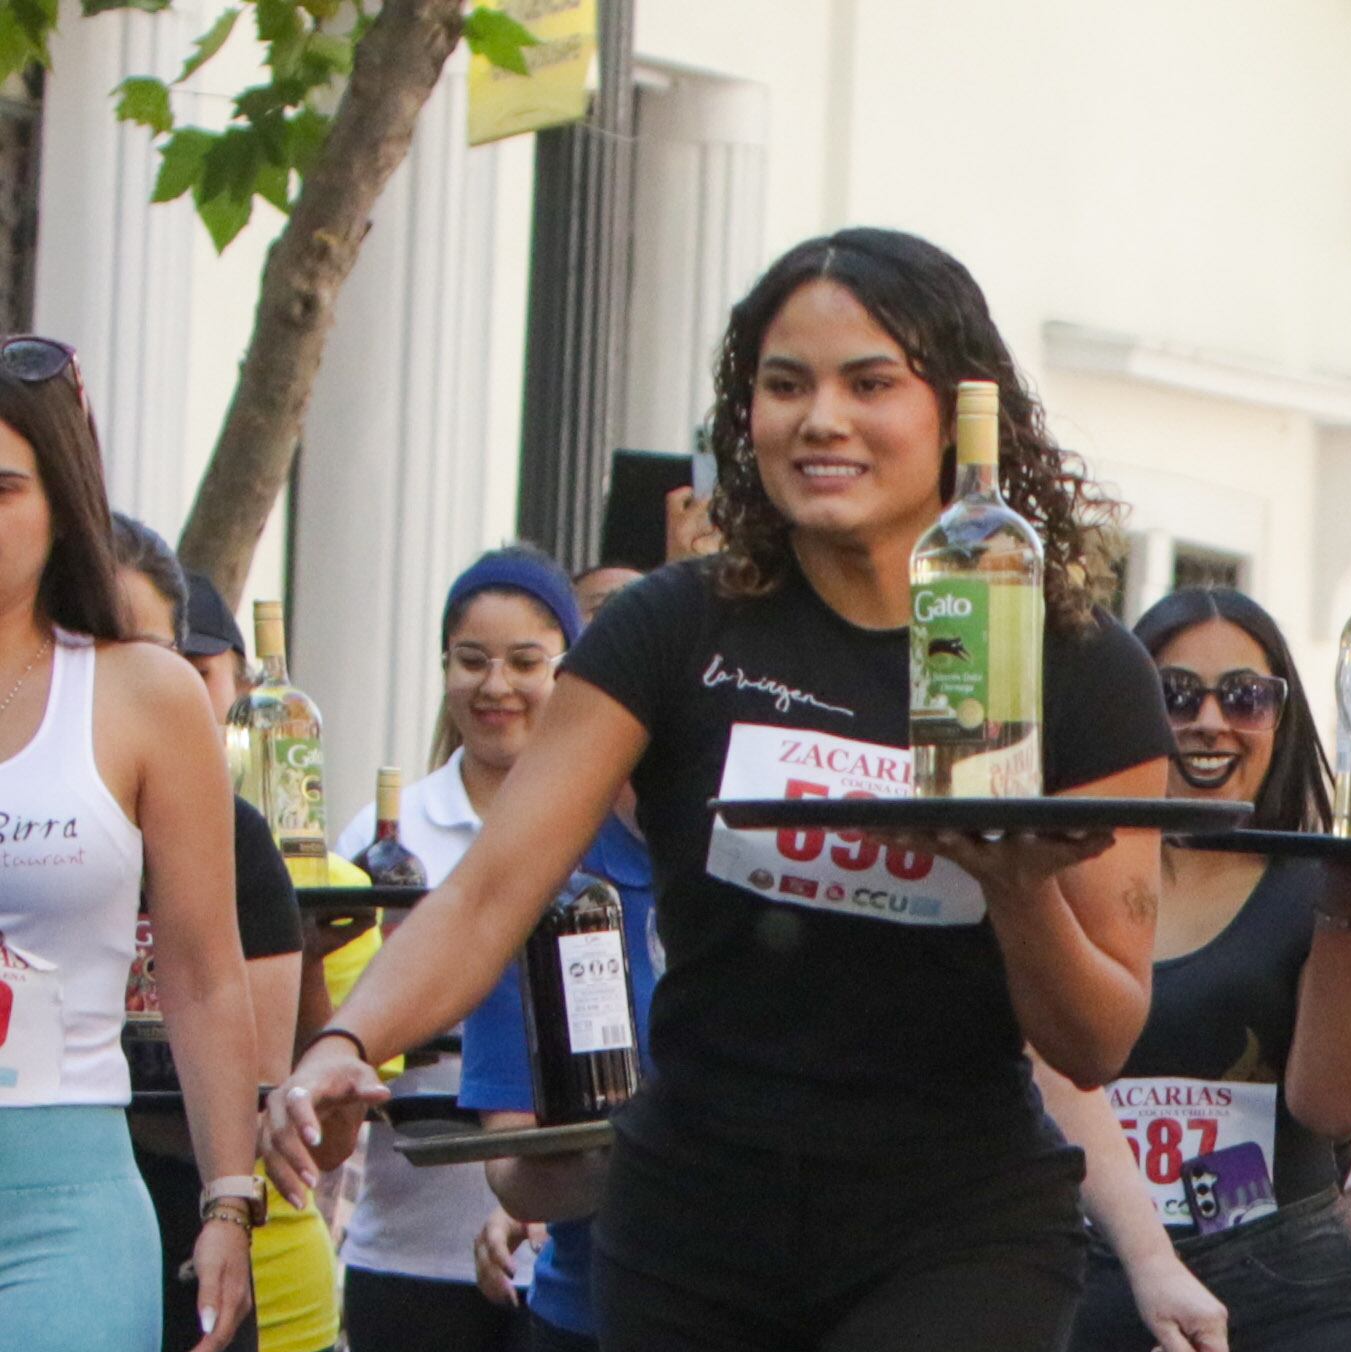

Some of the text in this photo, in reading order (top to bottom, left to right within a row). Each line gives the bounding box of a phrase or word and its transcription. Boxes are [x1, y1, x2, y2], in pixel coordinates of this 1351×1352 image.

[915, 591, 972, 622] Gato
[778, 739, 912, 784] ZACARI
[2, 847, 85, 867] taurant
[852, 887, 907, 913] CCU
[1110, 1086, 1232, 1107] ACARIAS
